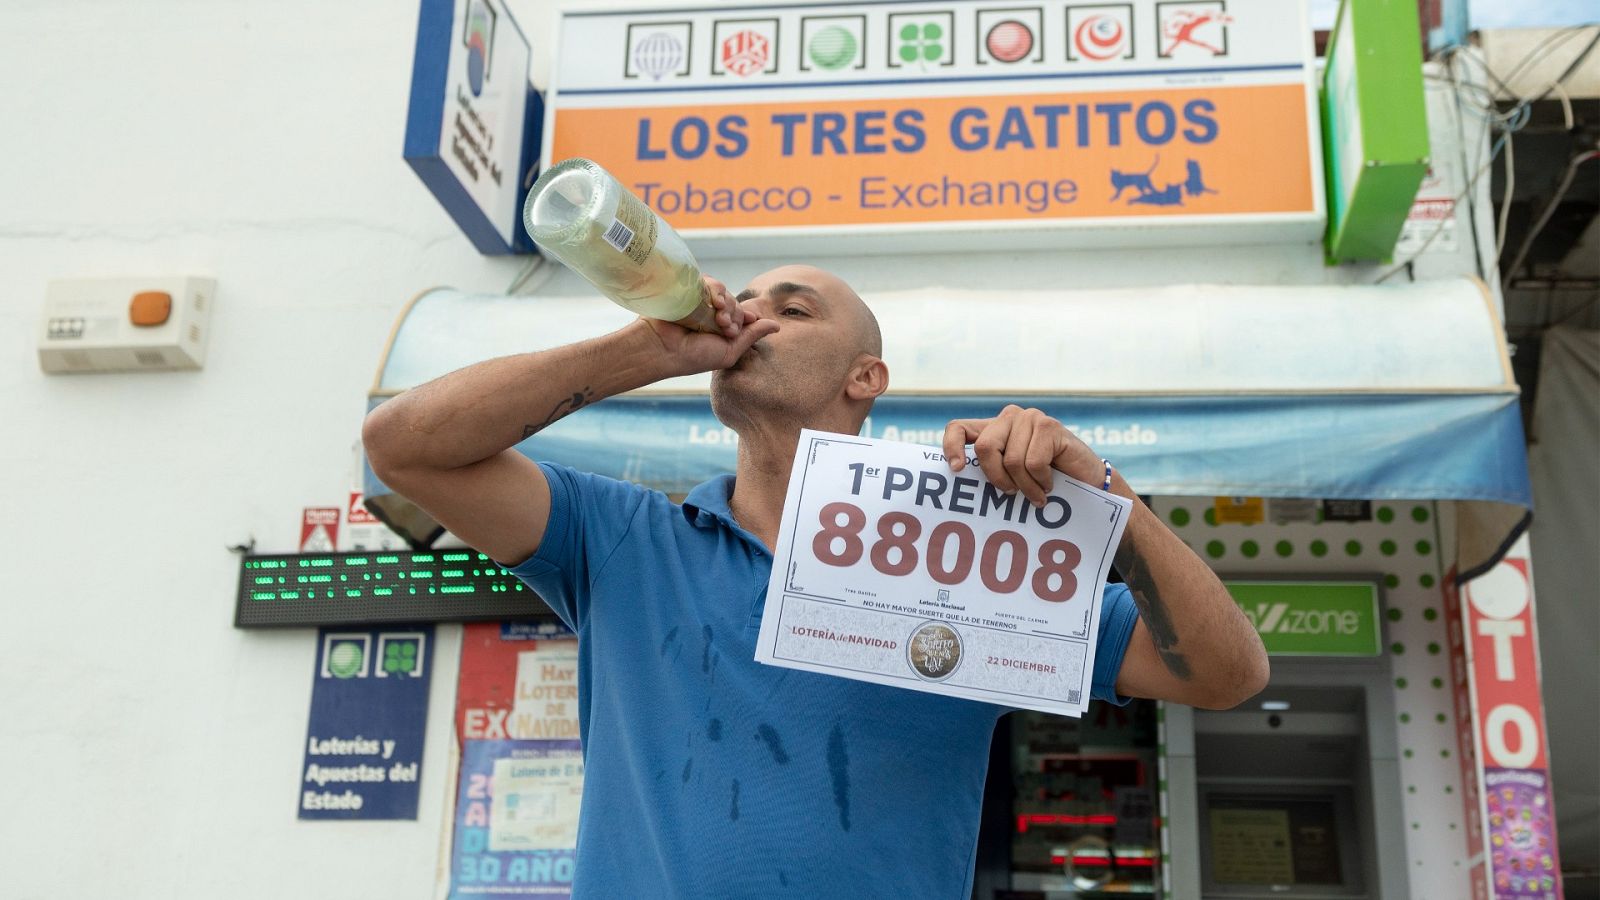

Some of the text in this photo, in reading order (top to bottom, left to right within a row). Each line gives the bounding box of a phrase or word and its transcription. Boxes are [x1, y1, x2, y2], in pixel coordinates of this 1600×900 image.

[636, 98, 1219, 161] LOS TRES GATITOS
[634, 182, 812, 215] Tobacco
[859, 176, 1078, 213] Exchange
[922, 451, 980, 467] VENDO
[848, 462, 1072, 529] 1er PREMIO
[812, 501, 1082, 603] 88008
[863, 600, 875, 608] NO
[876, 602, 891, 610] HAY
[892, 604, 918, 614] MAYOR
[918, 608, 944, 618] SUERTE
[945, 613, 960, 621] QUE
[960, 615, 971, 623] LA
[982, 618, 1018, 630] TENERNOS
[848, 634, 897, 650] NAVIDAD
[987, 656, 1057, 674] 22 DICIEMBRE
[309, 735, 396, 759] Loterías y
[305, 762, 418, 787] Apuestas del
[302, 790, 364, 810] Estado
